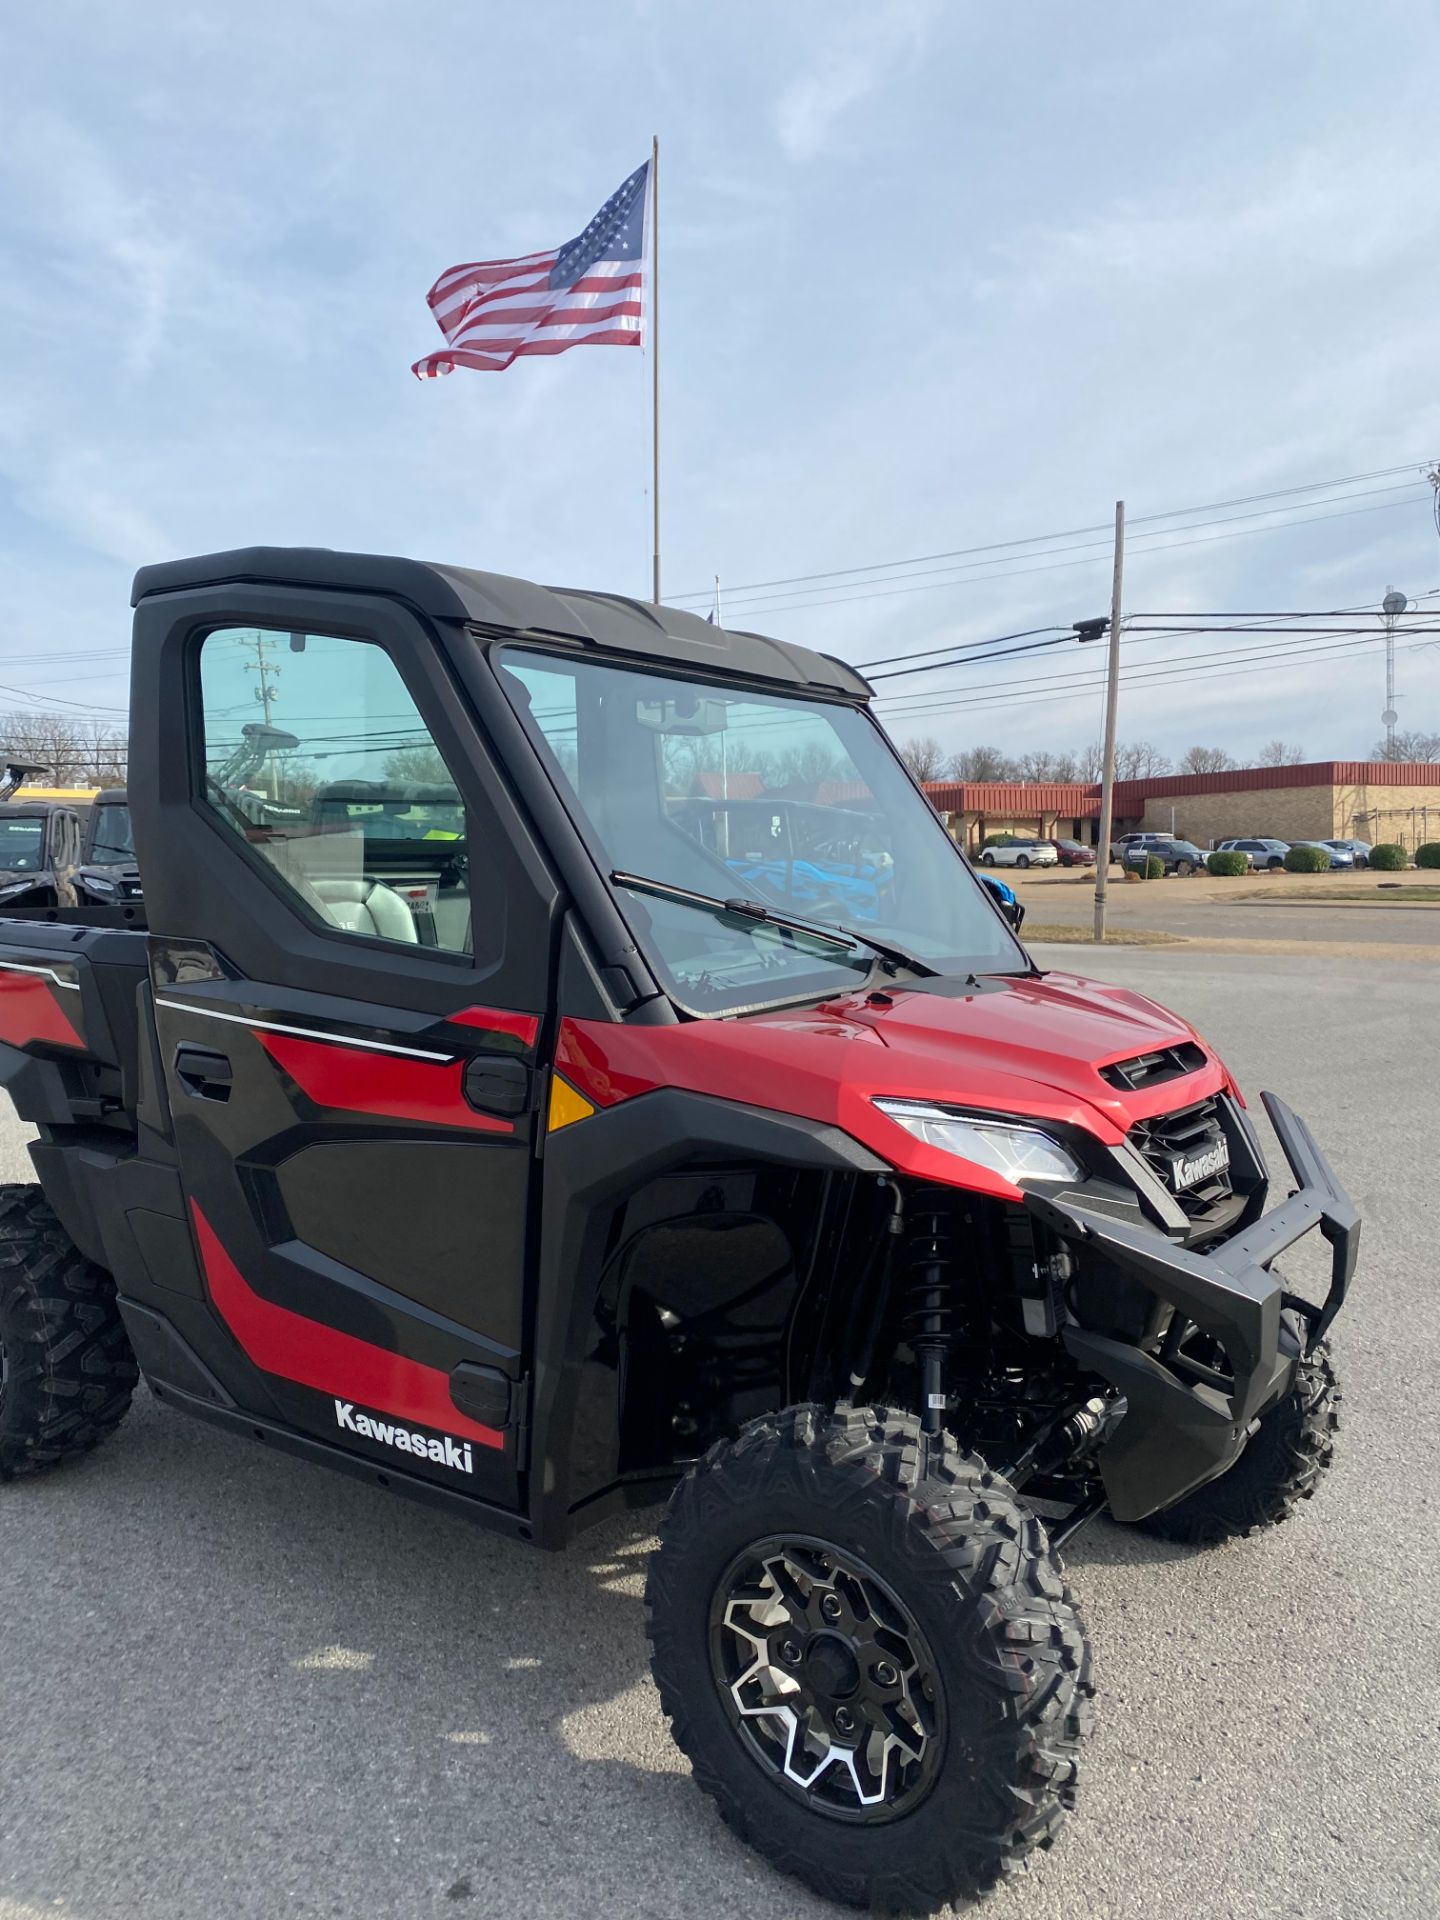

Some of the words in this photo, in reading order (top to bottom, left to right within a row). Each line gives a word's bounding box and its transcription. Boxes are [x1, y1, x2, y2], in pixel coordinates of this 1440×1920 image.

[1173, 1138, 1229, 1190] Kawasaki
[334, 1399, 473, 1474] Kawasaki
[999, 1592, 1025, 1614] DURO
